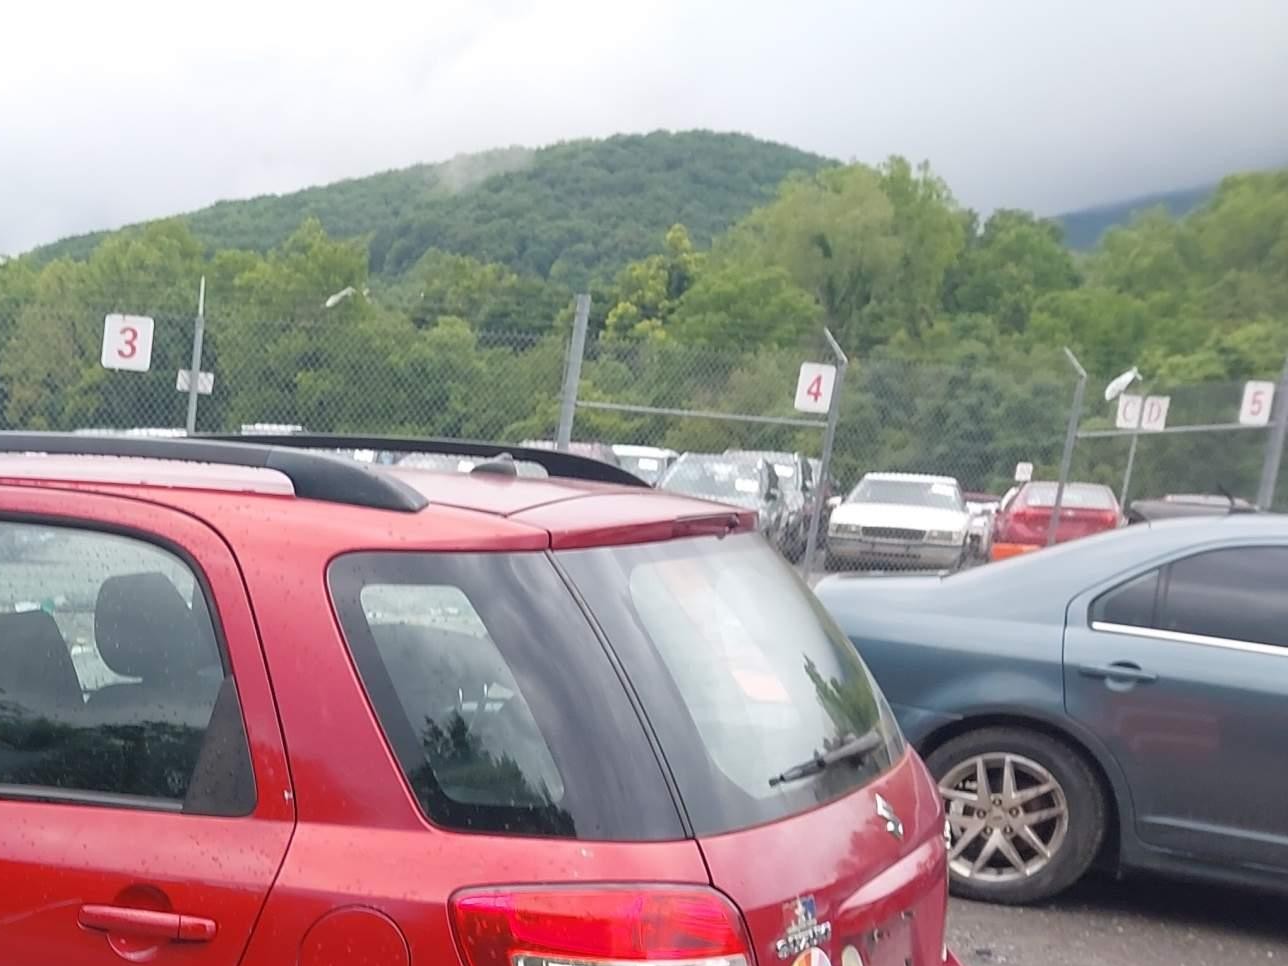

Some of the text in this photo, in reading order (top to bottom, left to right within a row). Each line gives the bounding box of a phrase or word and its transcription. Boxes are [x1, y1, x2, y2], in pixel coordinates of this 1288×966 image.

[118, 326, 140, 360] 3
[807, 374, 823, 402] 4
[1122, 401, 1135, 424] C
[1146, 401, 1162, 423] D
[1249, 390, 1264, 417] 5
